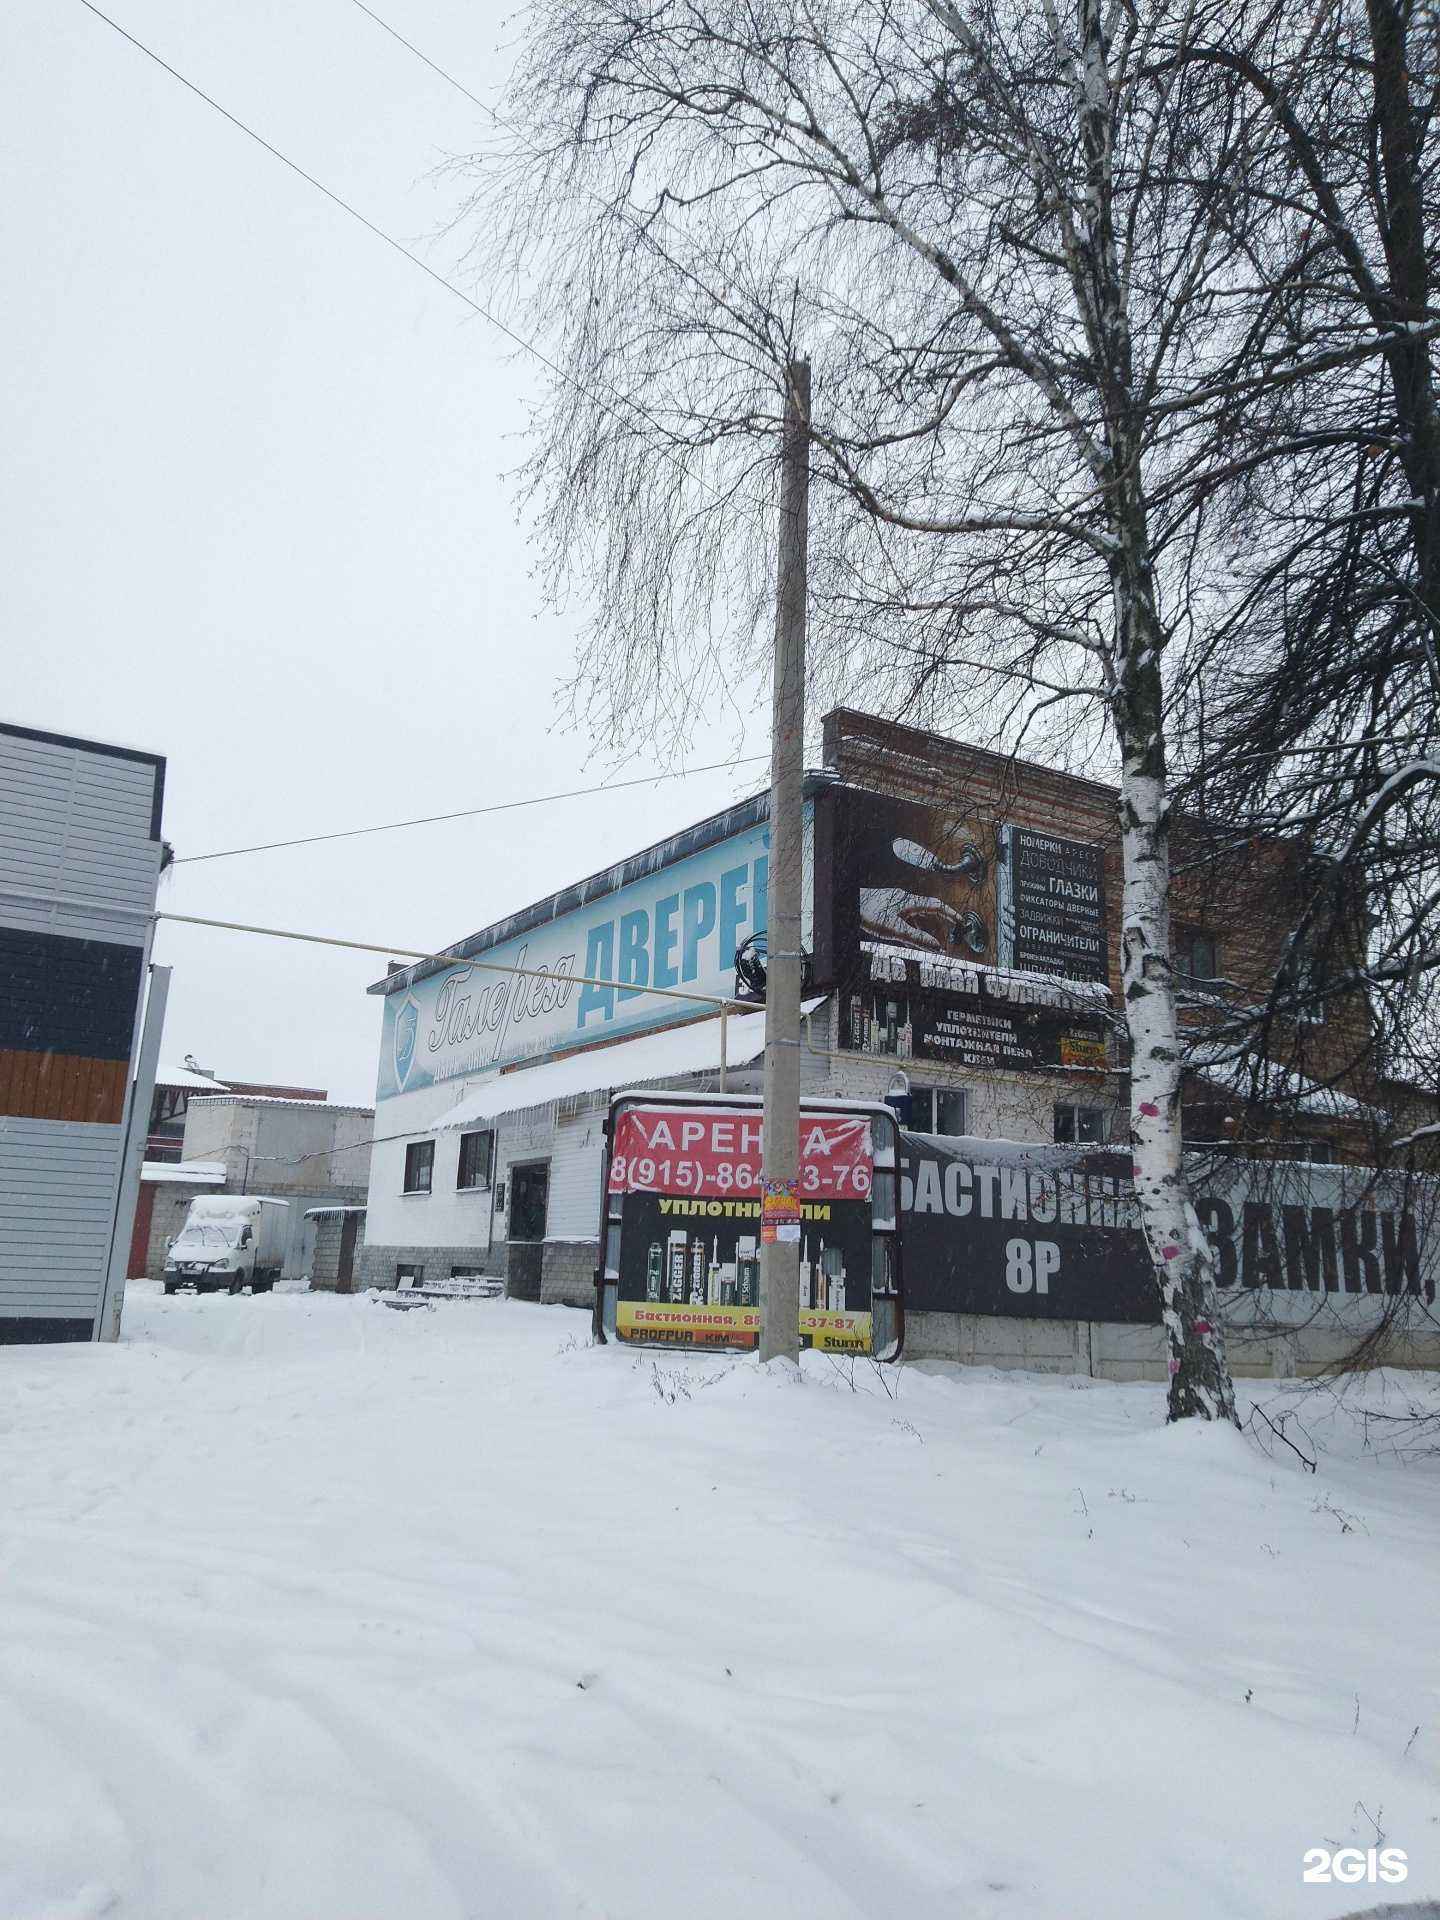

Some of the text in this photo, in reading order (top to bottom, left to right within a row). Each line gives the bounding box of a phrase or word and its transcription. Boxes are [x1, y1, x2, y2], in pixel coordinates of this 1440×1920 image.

[1048, 877, 1098, 902] ГЛАЗКИ
[1019, 924, 1100, 952] ОГРАНИЧИТЕЛИ
[649, 1119, 832, 1157] АРЕНА
[1005, 1238, 1061, 1295] 8Р
